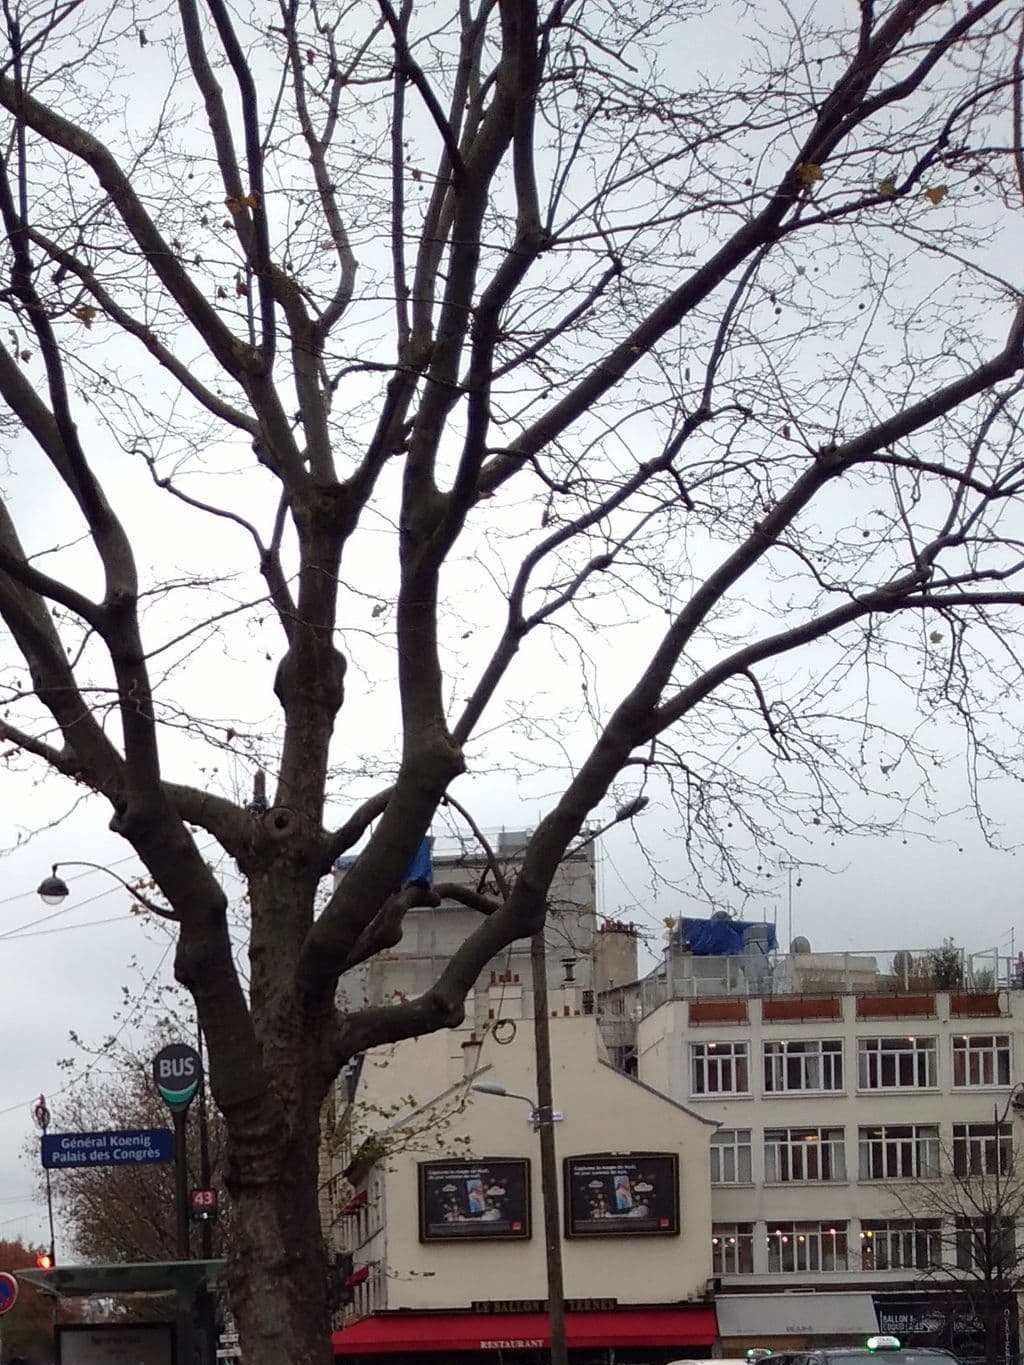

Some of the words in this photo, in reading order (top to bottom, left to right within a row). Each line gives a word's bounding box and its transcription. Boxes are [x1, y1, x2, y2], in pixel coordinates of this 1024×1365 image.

[159, 1057, 194, 1077] BUS
[61, 1136, 107, 1149] Général
[110, 1135, 151, 1148] Koenig
[52, 1151, 86, 1162] Palais
[90, 1150, 110, 1161] des
[113, 1148, 160, 1161] Congrès
[194, 1191, 212, 1204] 43
[494, 1302, 539, 1312] BALLON
[480, 1340, 544, 1349] RESTAURANT
